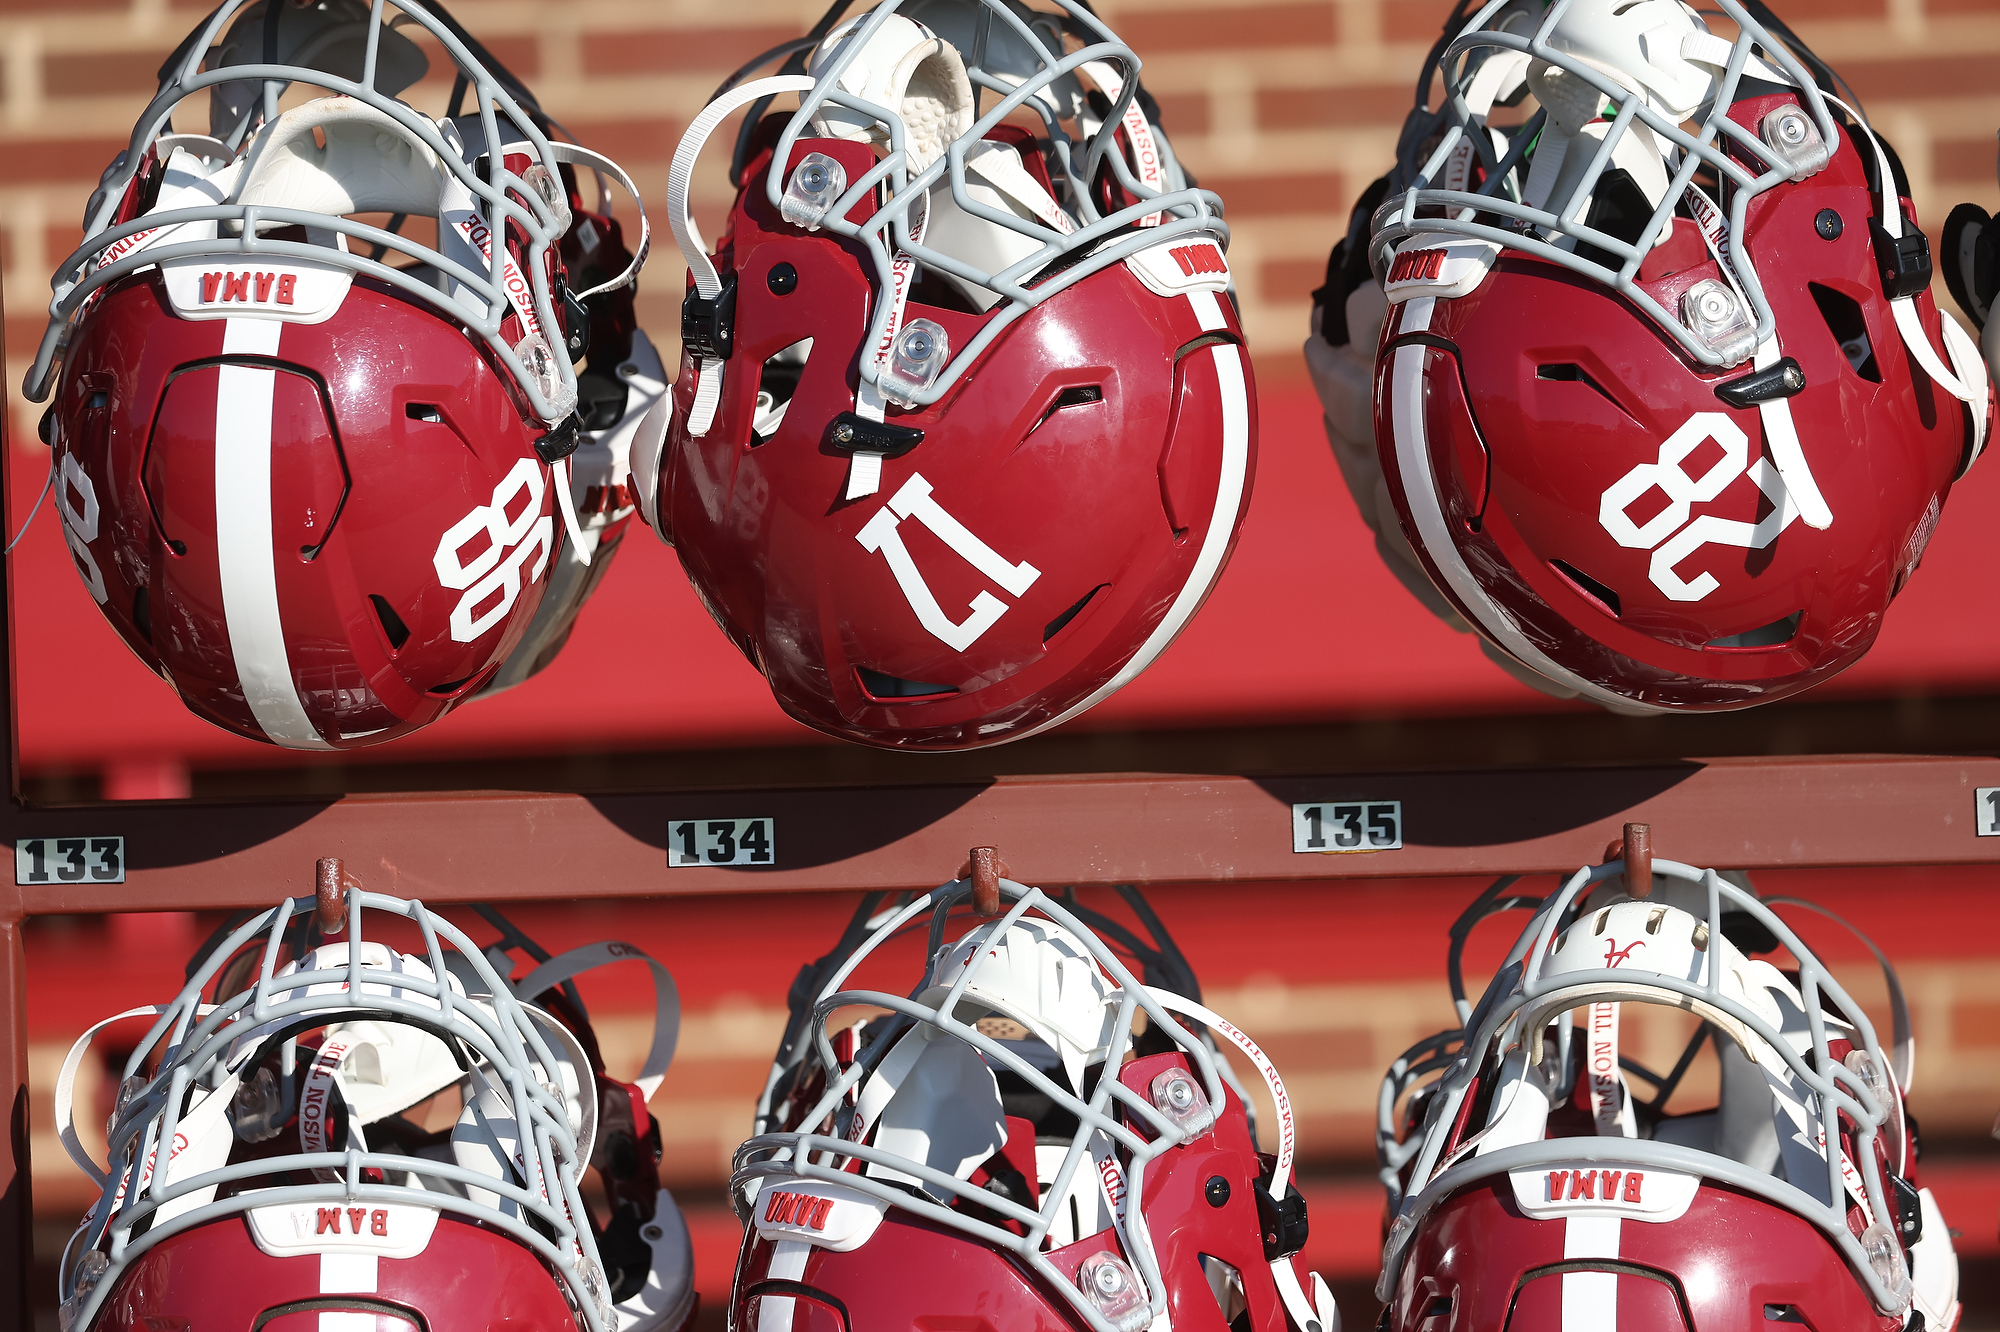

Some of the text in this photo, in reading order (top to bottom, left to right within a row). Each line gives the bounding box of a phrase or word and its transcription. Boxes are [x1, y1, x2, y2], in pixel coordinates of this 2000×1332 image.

[202, 271, 298, 306] BAMA
[1598, 411, 1801, 602] 28
[854, 471, 1043, 653] 17
[676, 820, 770, 864] 134
[1303, 804, 1396, 848] 135
[25, 838, 120, 882] 133
[312, 1042, 349, 1079] TIDE
[1218, 1020, 1295, 1169] CRIMSON TIDE
[1098, 1153, 1128, 1207] TIDE
[1549, 1169, 1645, 1204] BAMA
[763, 1191, 835, 1231] BAMA
